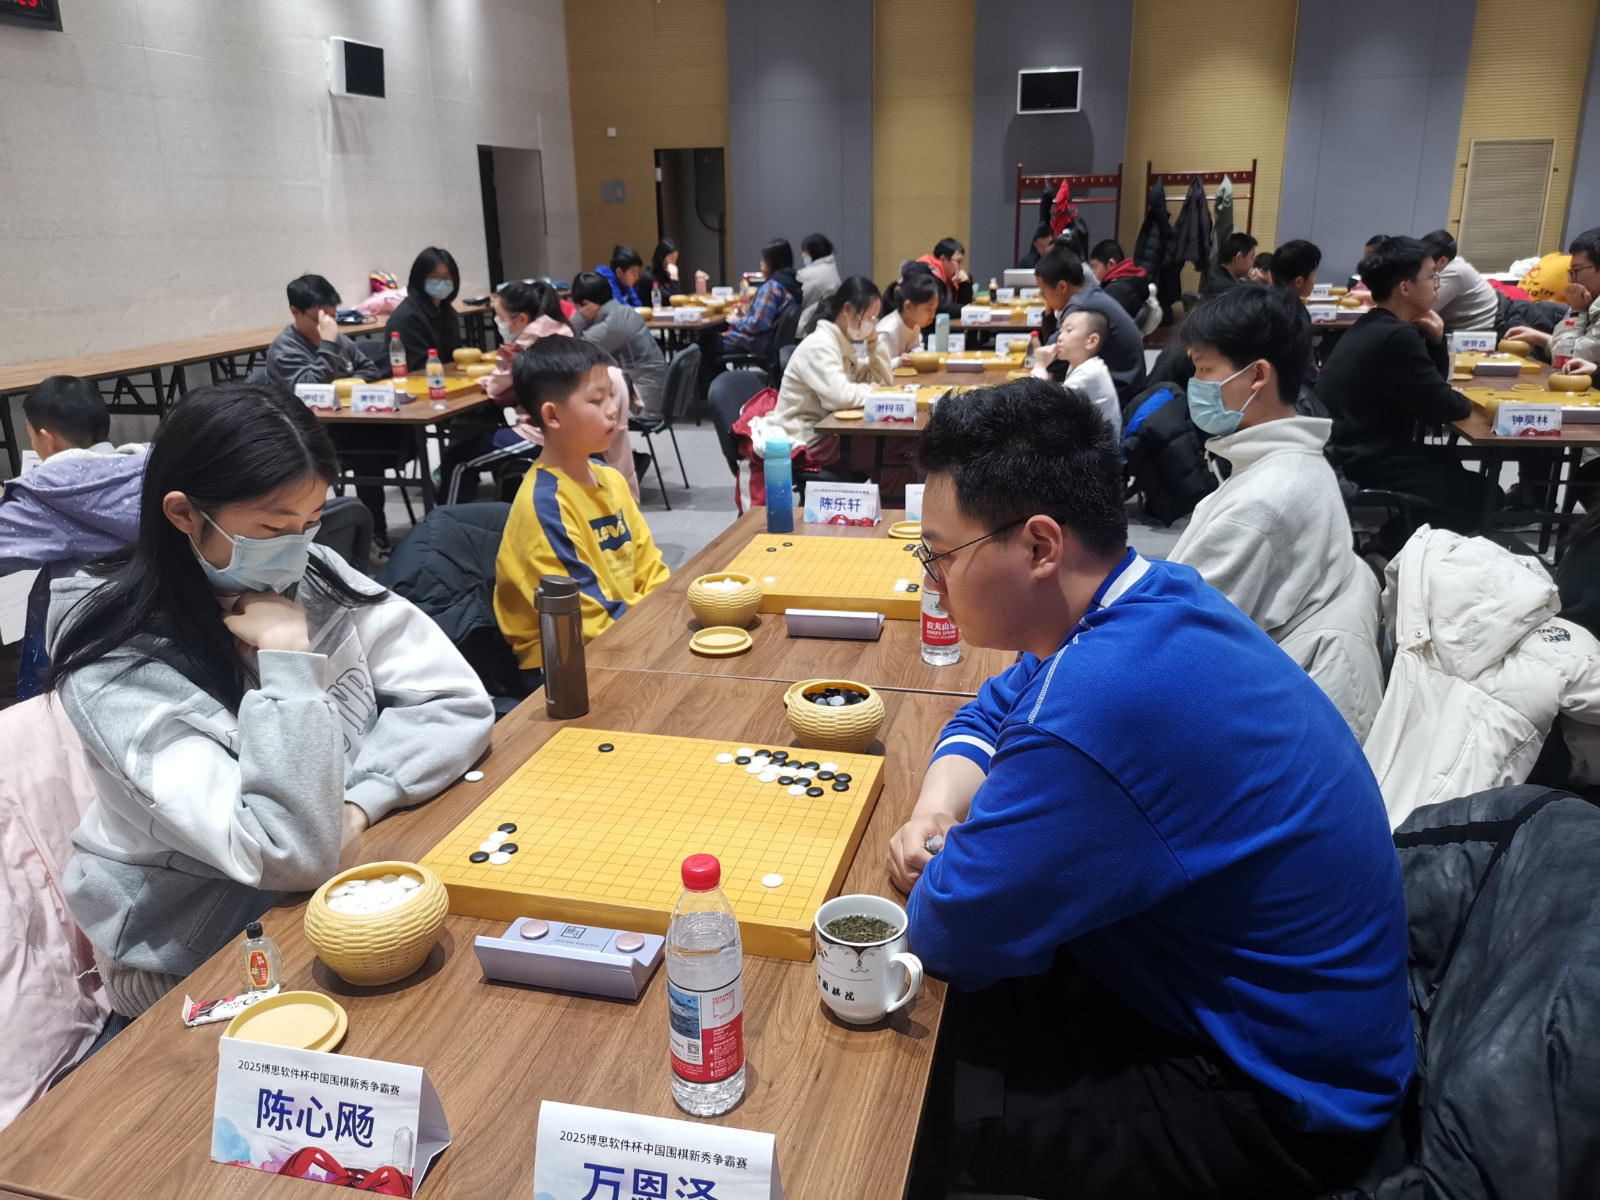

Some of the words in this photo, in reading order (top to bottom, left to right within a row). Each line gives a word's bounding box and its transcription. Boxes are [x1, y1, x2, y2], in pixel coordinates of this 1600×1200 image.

[819, 497, 862, 513] 陈乐轩
[237, 1059, 401, 1097] 2025博思软件杯中国围棋新秀争霸赛
[256, 1087, 376, 1148] 陈心飏
[559, 1130, 748, 1170] 2025博思软件杯中国围棋新秀争霸赛
